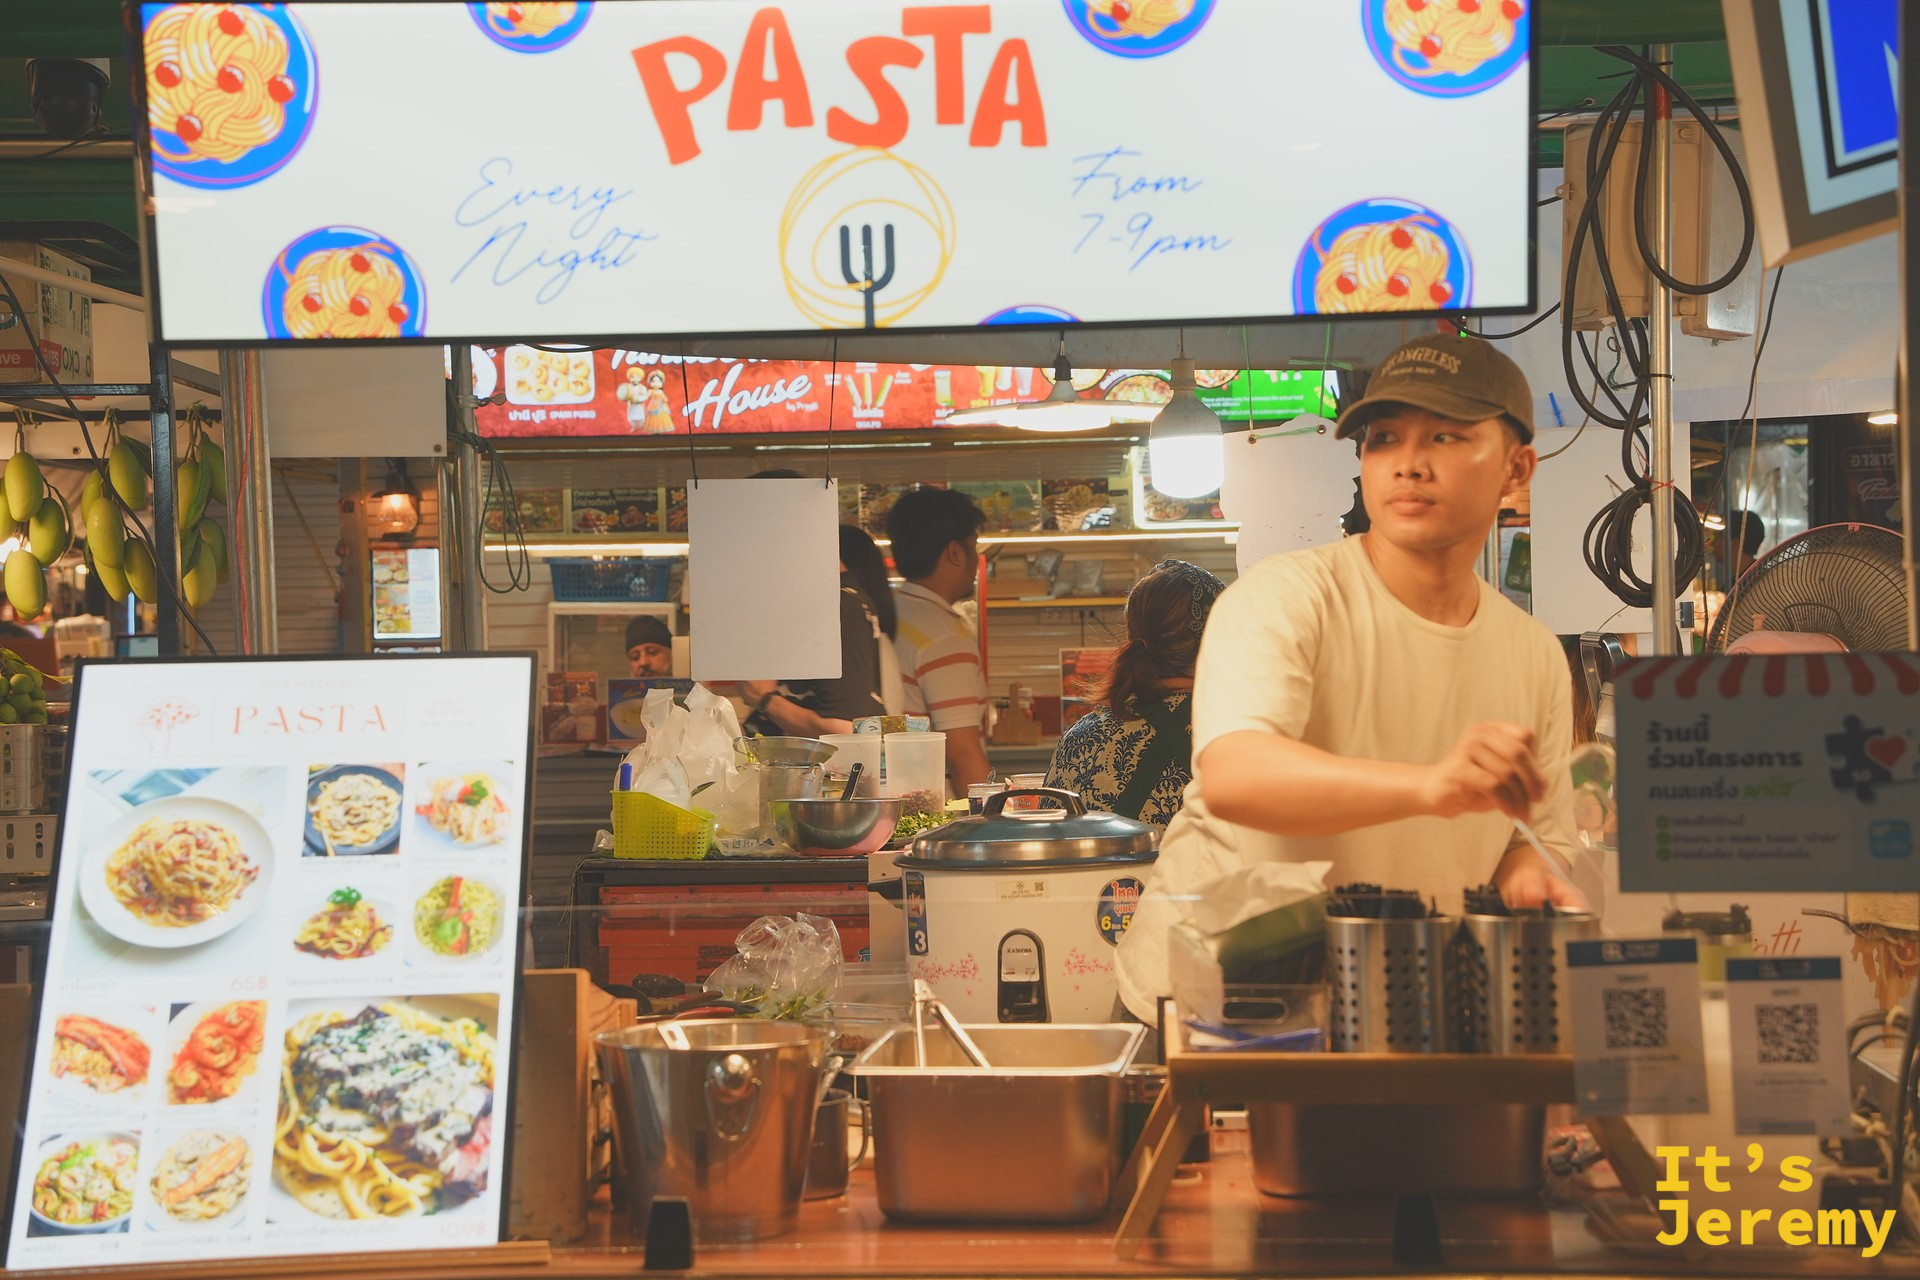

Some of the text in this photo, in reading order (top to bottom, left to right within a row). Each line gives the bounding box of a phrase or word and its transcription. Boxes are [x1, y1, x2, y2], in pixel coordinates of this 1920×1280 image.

[631, 6, 1048, 165] PASTA
[455, 158, 635, 237] Every
[1070, 146, 1204, 200] From
[449, 223, 661, 305] Night
[1072, 214, 1235, 272] 7-9pm
[682, 363, 813, 430] House
[232, 704, 388, 735] PASTA
[1647, 713, 1710, 742] ร้านนี้
[1648, 746, 1804, 769] ร่วมโครงการ
[914, 930, 927, 952] 3
[1101, 915, 1112, 931] 6
